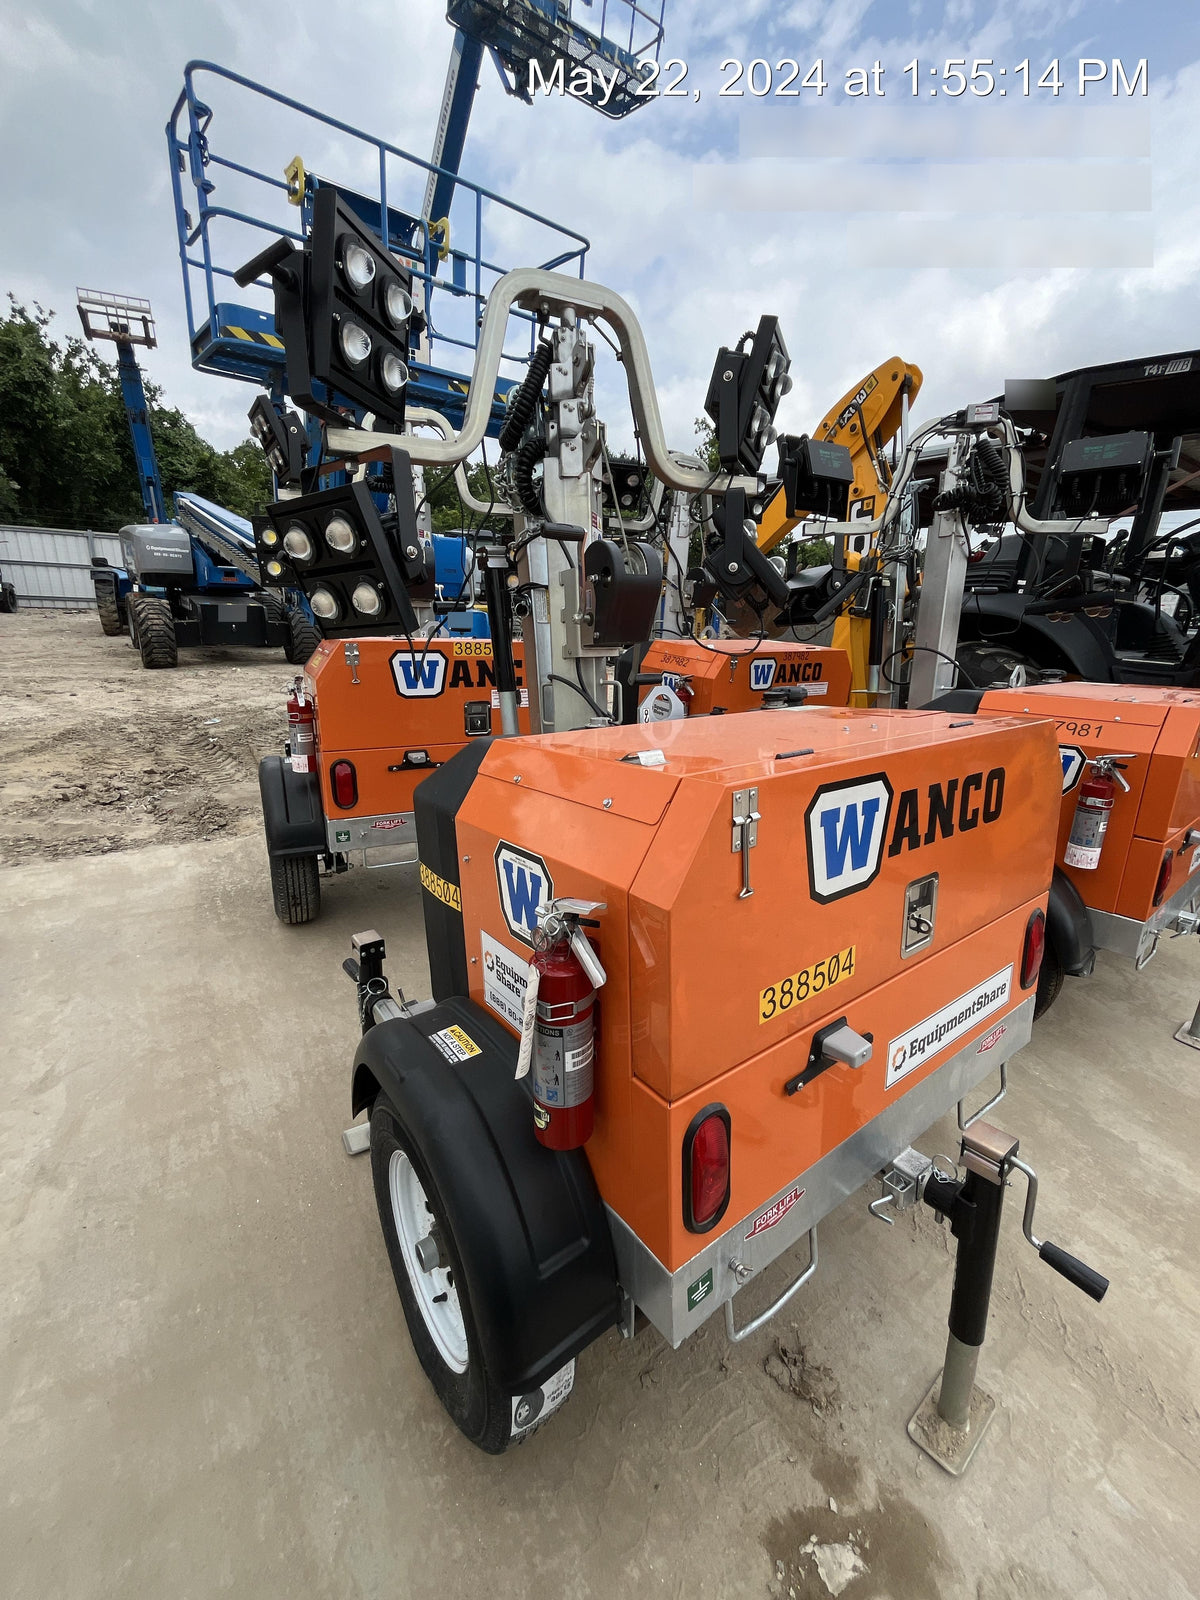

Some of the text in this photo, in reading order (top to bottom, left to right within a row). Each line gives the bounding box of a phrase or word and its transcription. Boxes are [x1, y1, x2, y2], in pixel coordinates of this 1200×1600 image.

[454, 642, 492, 655] 3885
[660, 654, 690, 668] 387982
[783, 651, 810, 661] 387982
[752, 661, 823, 687] WANCO
[1055, 720, 1103, 739] 7981
[815, 767, 1006, 886] WANCO
[494, 953, 528, 989] Equipm
[495, 968, 521, 998] Share
[762, 947, 854, 1019] 388504
[908, 982, 1007, 1059] EquipmentShare
[441, 1032, 453, 1042] NOT
[453, 1043, 467, 1056] STEP
[453, 1030, 477, 1053] CAUTION
[756, 1204, 778, 1229] FORK
[779, 1190, 797, 1210] LIFT
